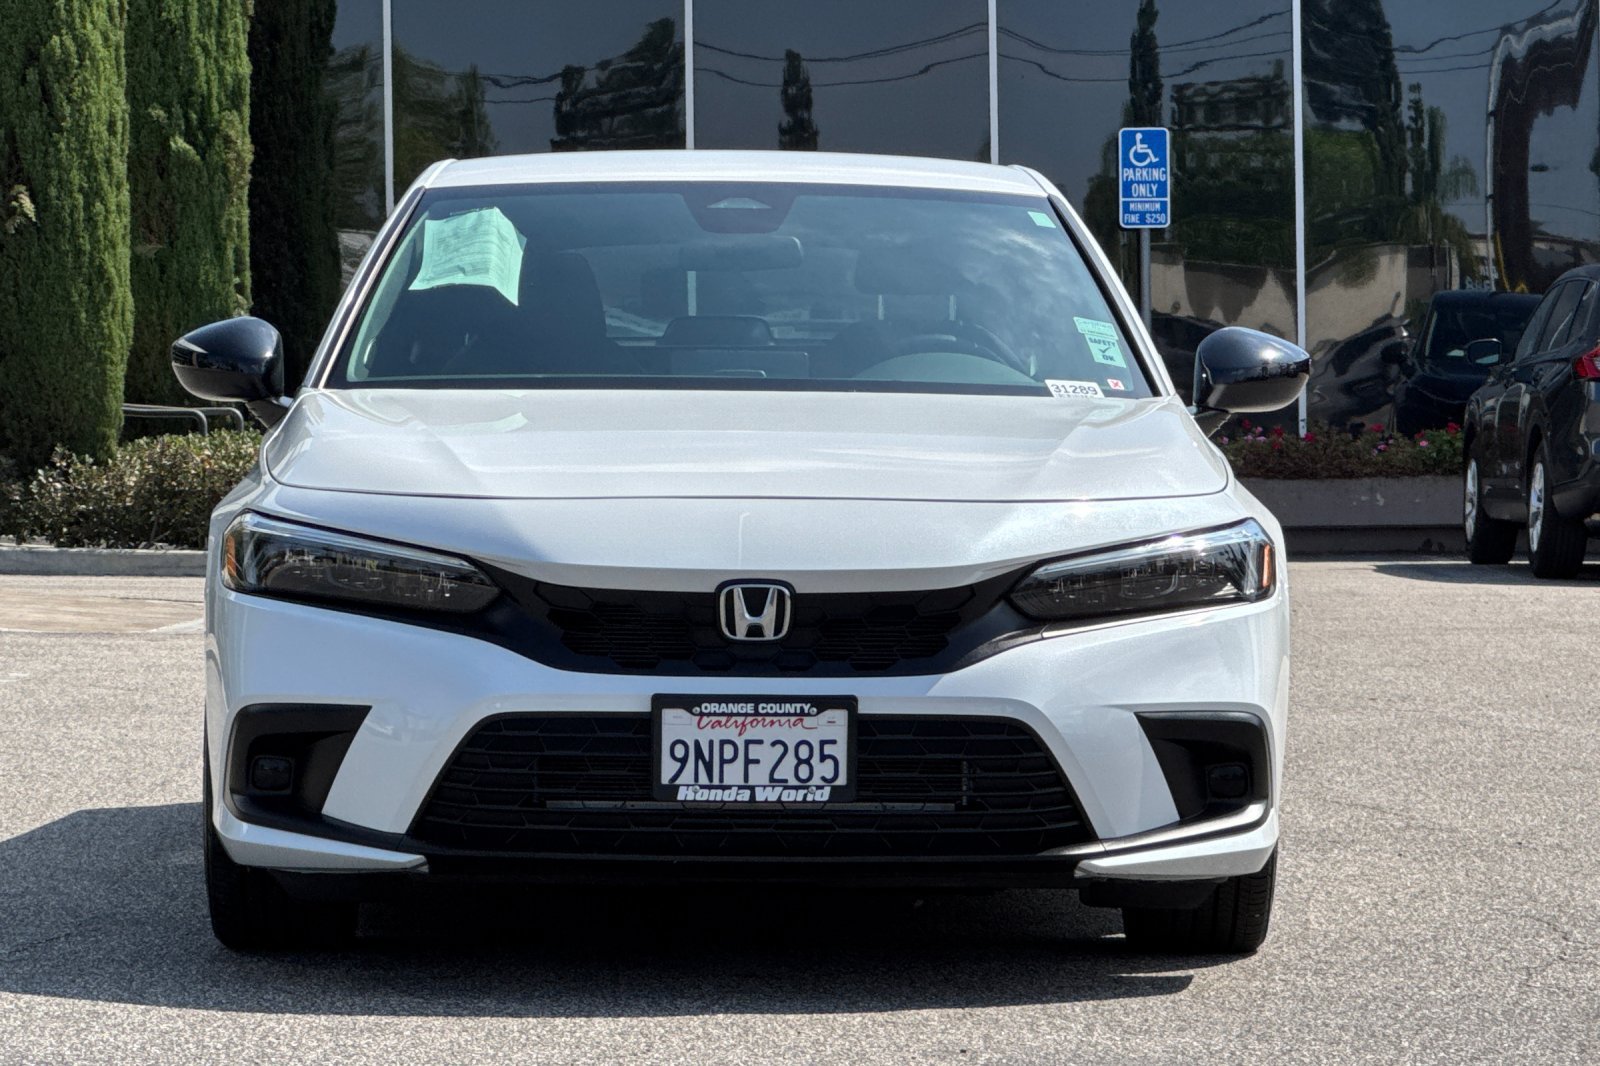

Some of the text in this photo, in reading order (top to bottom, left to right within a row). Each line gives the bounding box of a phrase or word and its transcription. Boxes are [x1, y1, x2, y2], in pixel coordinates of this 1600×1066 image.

[1123, 167, 1166, 181] PARKING
[1131, 183, 1158, 197] ONLY
[1129, 202, 1161, 212] MINIMUM
[1124, 213, 1166, 224] FINE $250
[1088, 337, 1116, 347] SAFETY
[1102, 354, 1116, 362] OK
[1051, 383, 1098, 395] 31289
[701, 703, 811, 714] ORANGE COUNTY
[696, 715, 818, 737] California
[668, 738, 840, 784] 9NPF285
[676, 785, 831, 802] Honda World
